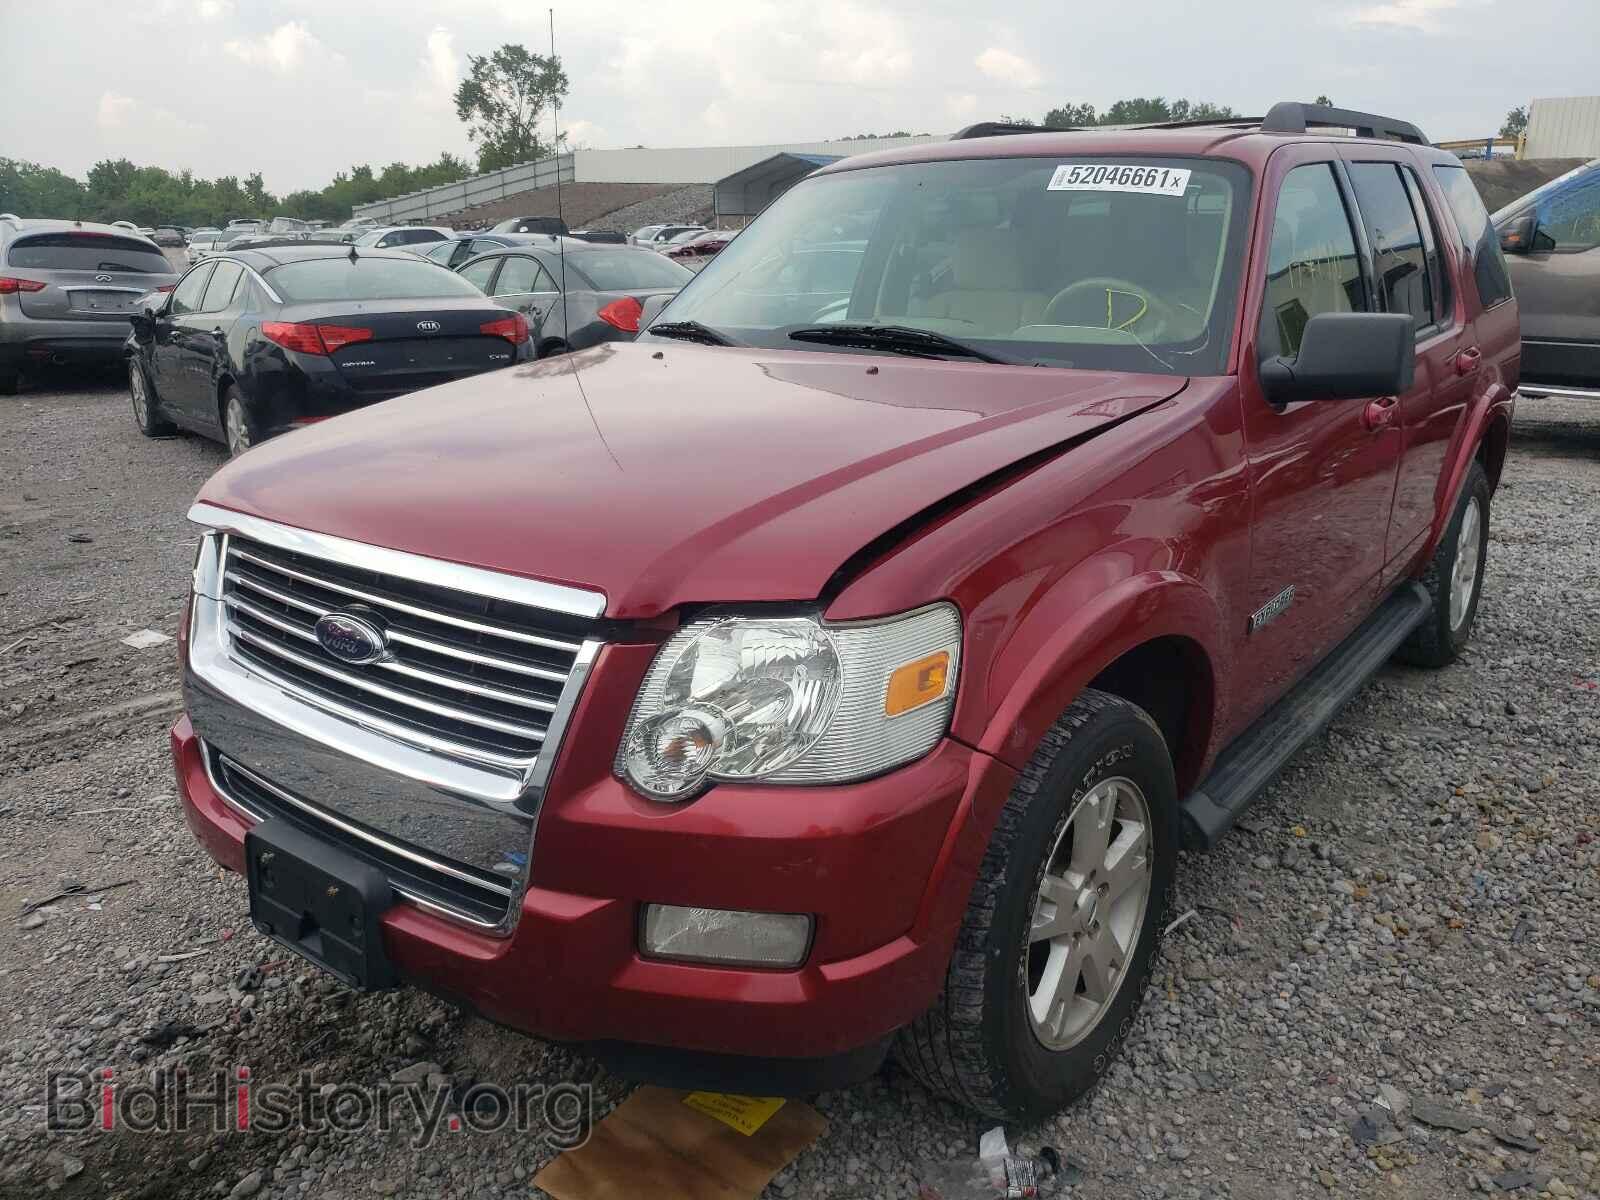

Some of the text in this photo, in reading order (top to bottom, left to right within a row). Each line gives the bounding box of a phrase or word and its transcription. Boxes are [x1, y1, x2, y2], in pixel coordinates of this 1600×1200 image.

[1066, 166, 1170, 188] 52046661
[418, 321, 439, 331] KIA
[320, 624, 361, 654] Ford
